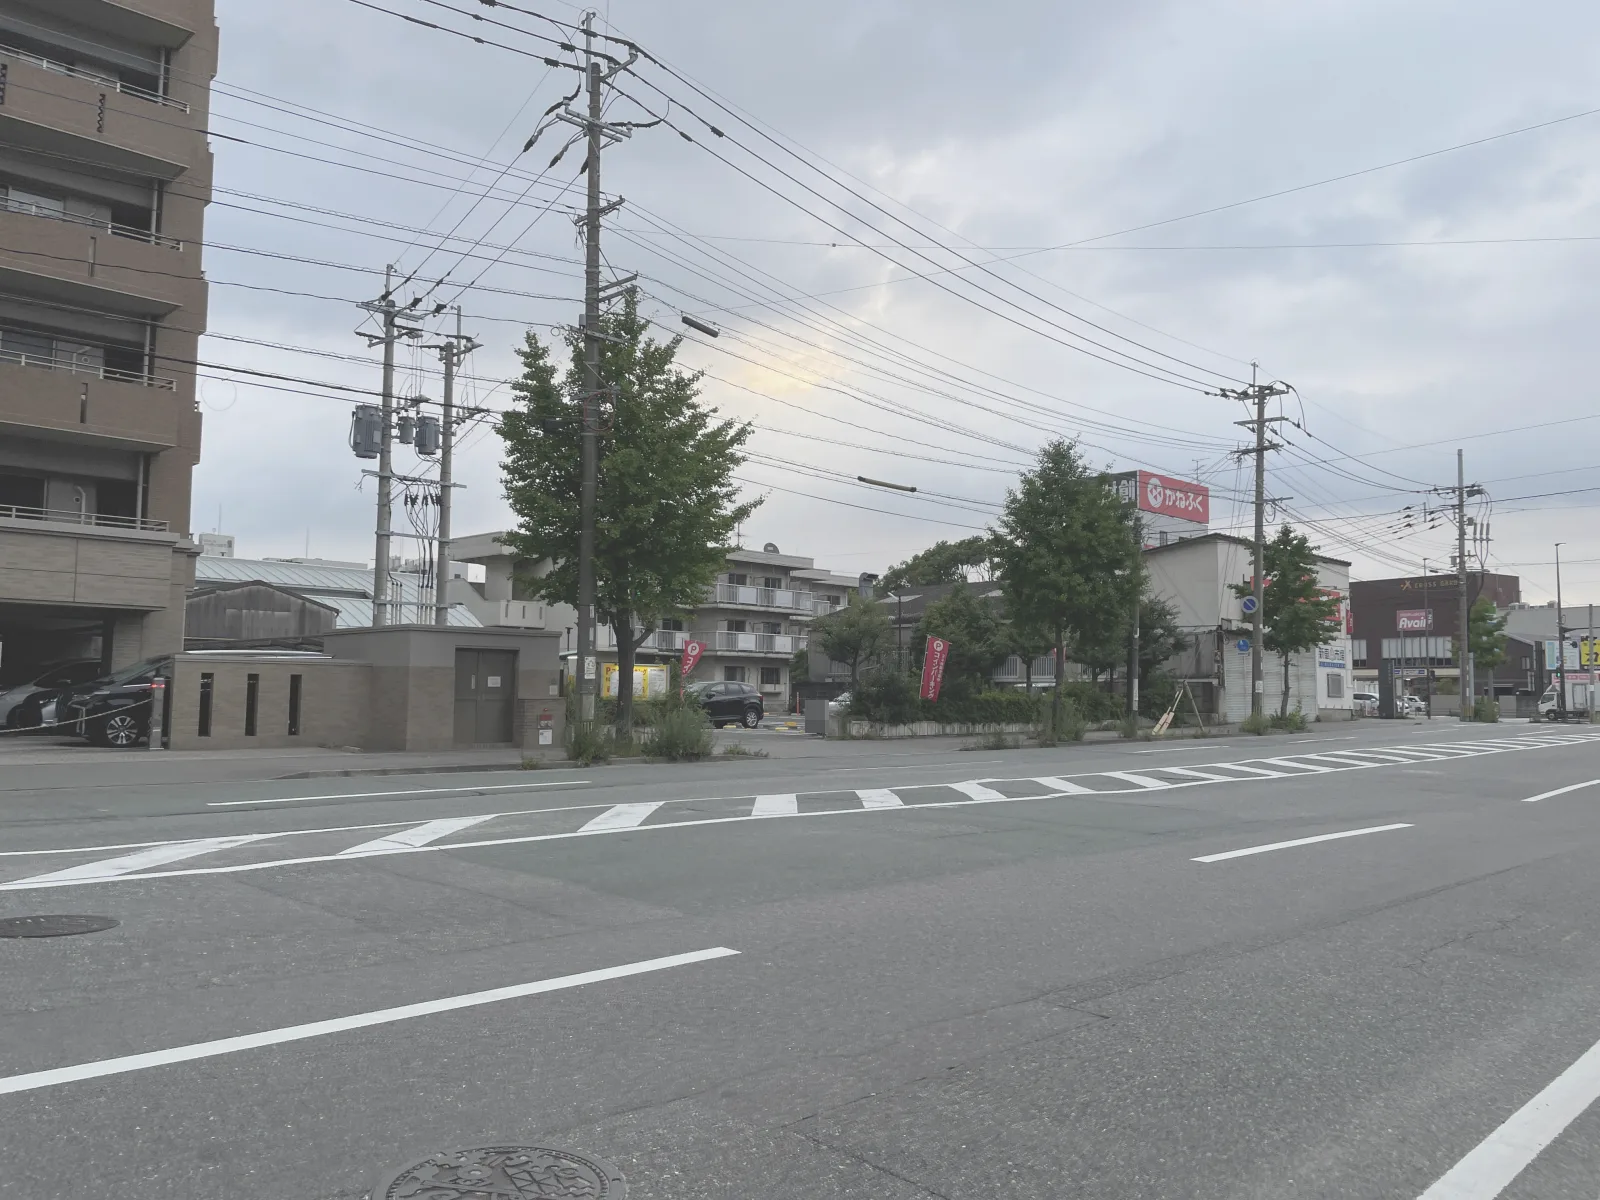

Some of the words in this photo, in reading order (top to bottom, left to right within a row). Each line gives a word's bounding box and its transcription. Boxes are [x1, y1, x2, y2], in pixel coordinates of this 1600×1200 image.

[1165, 488, 1203, 513] かねふく
[1399, 616, 1426, 629] Avail
[927, 651, 940, 698] コインパーキング
